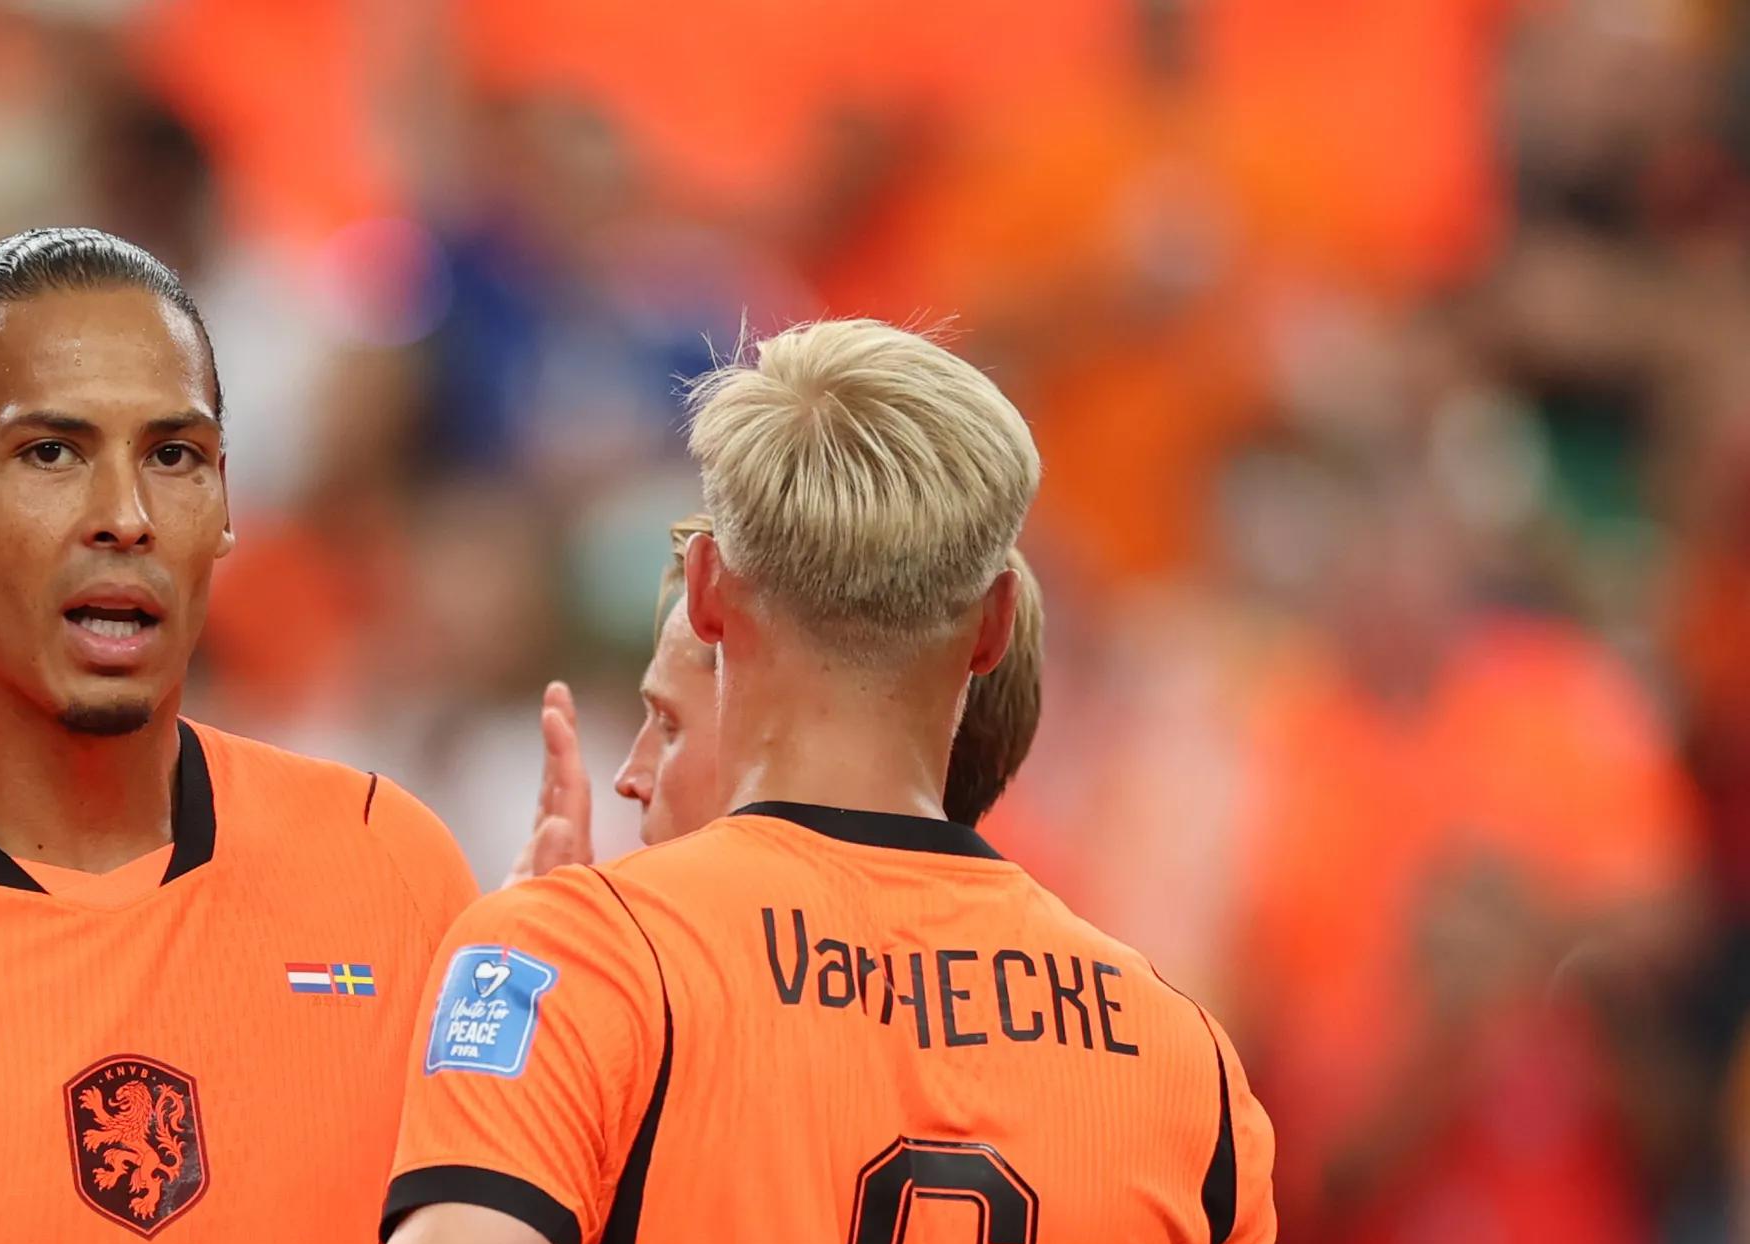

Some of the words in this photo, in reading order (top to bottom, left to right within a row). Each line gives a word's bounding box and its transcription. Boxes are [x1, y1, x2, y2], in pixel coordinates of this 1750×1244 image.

[446, 1020, 501, 1045] PEACE
[450, 1044, 479, 1057] FIFA
[104, 1065, 149, 1081] KNVB
